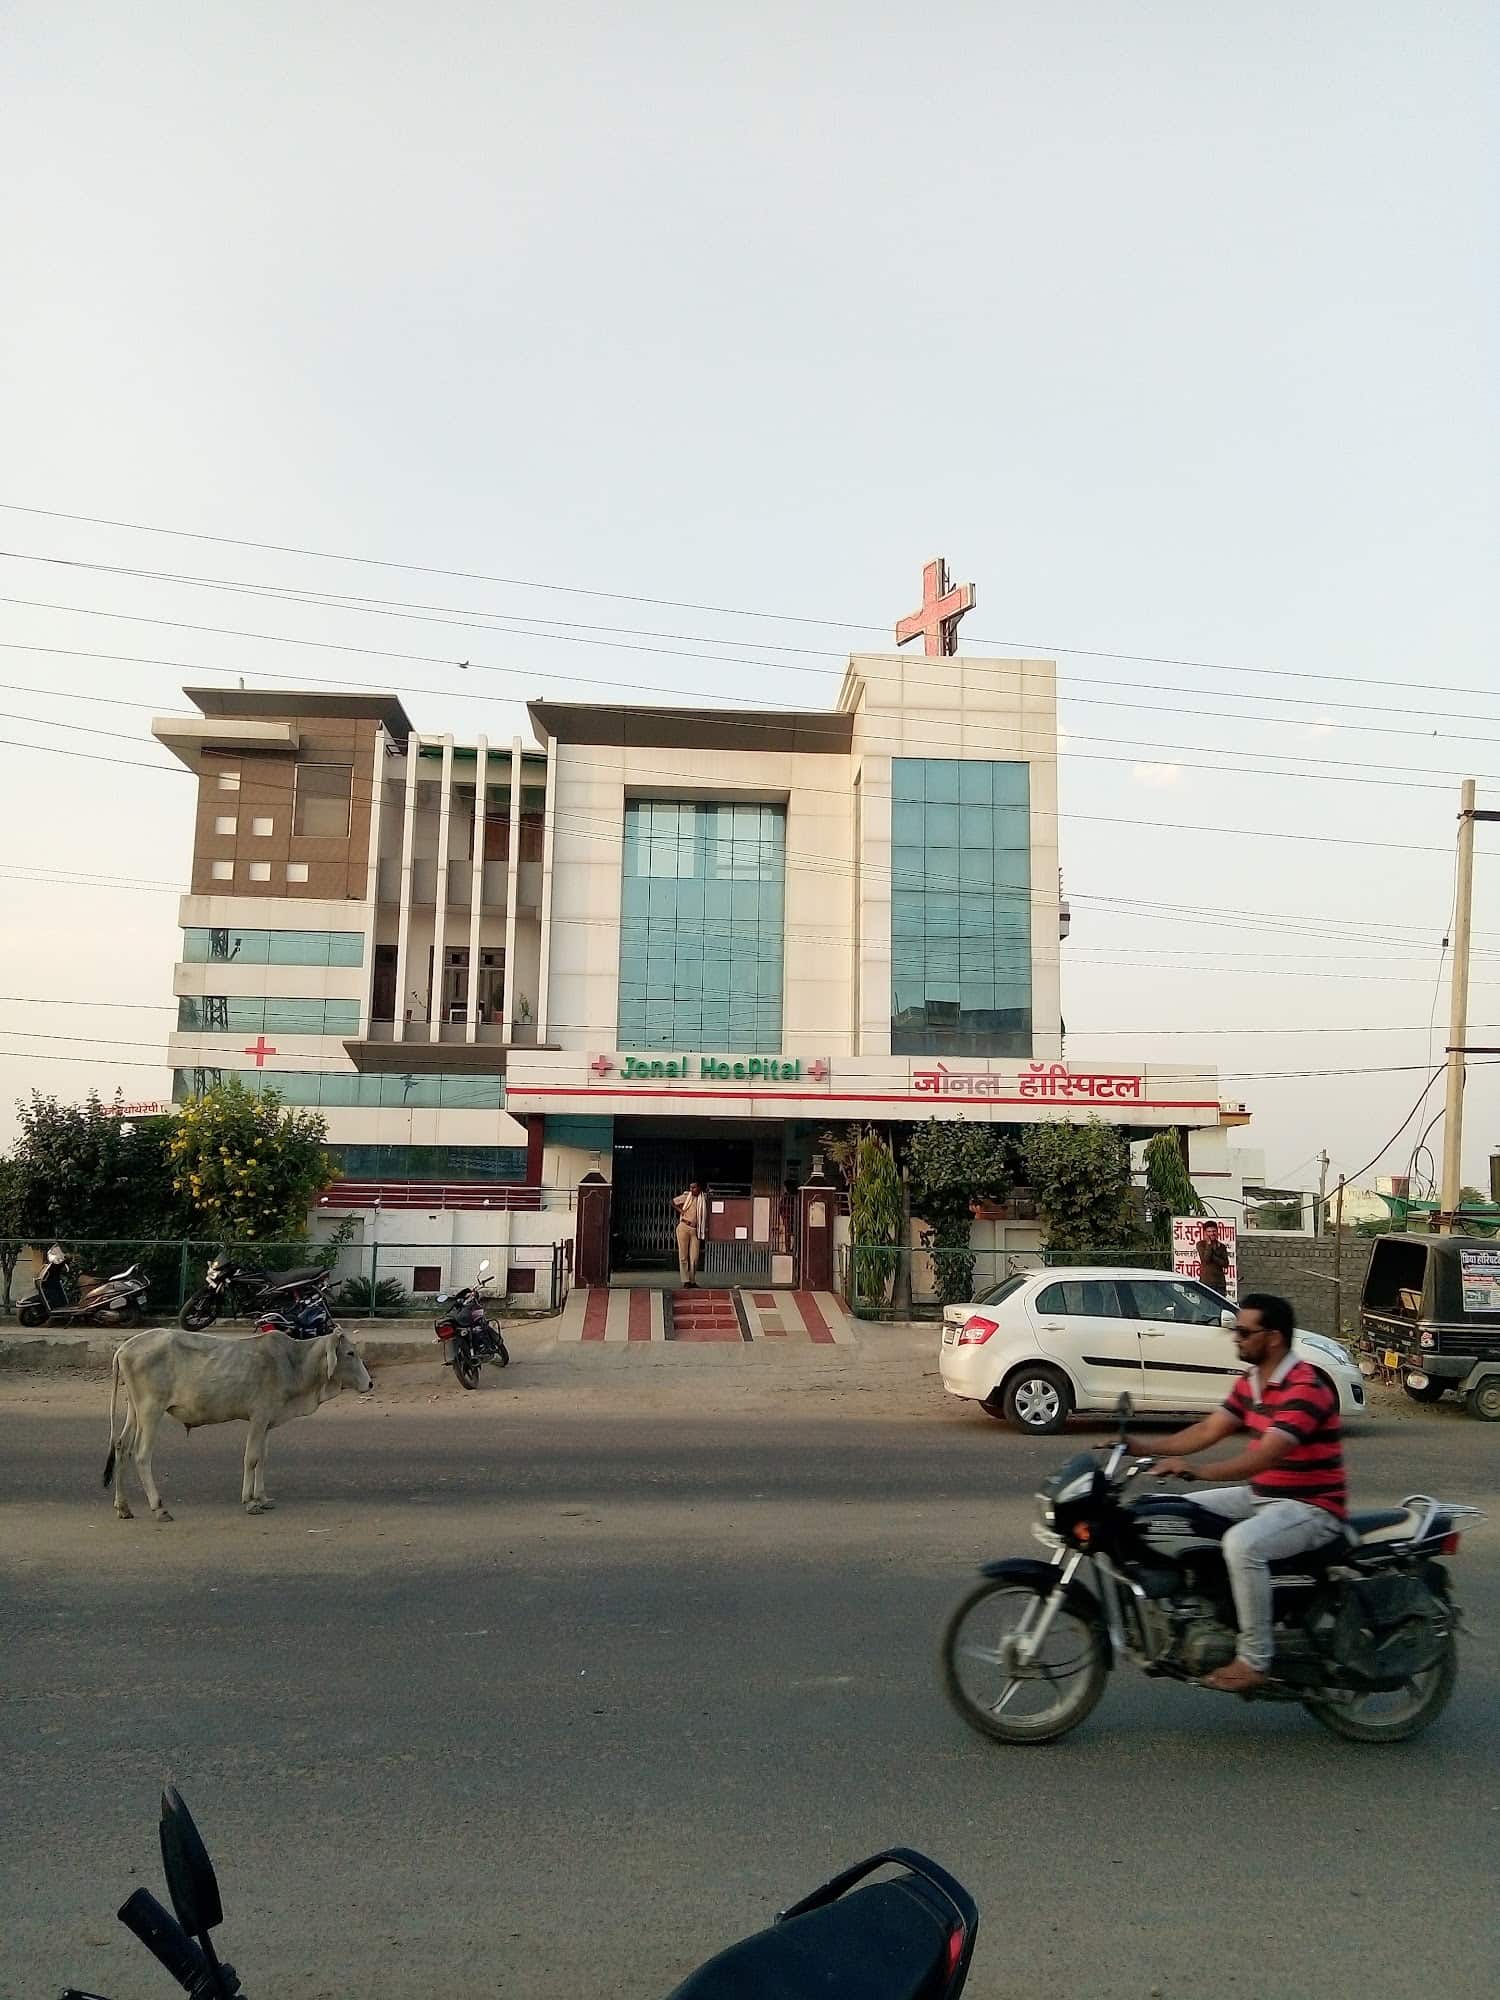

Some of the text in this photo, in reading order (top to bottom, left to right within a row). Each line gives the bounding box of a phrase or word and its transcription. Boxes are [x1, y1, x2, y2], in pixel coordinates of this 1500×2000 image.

[620, 1056, 687, 1079] Jonal
[913, 1062, 1142, 1098] जोनल हॉस्पिटल
